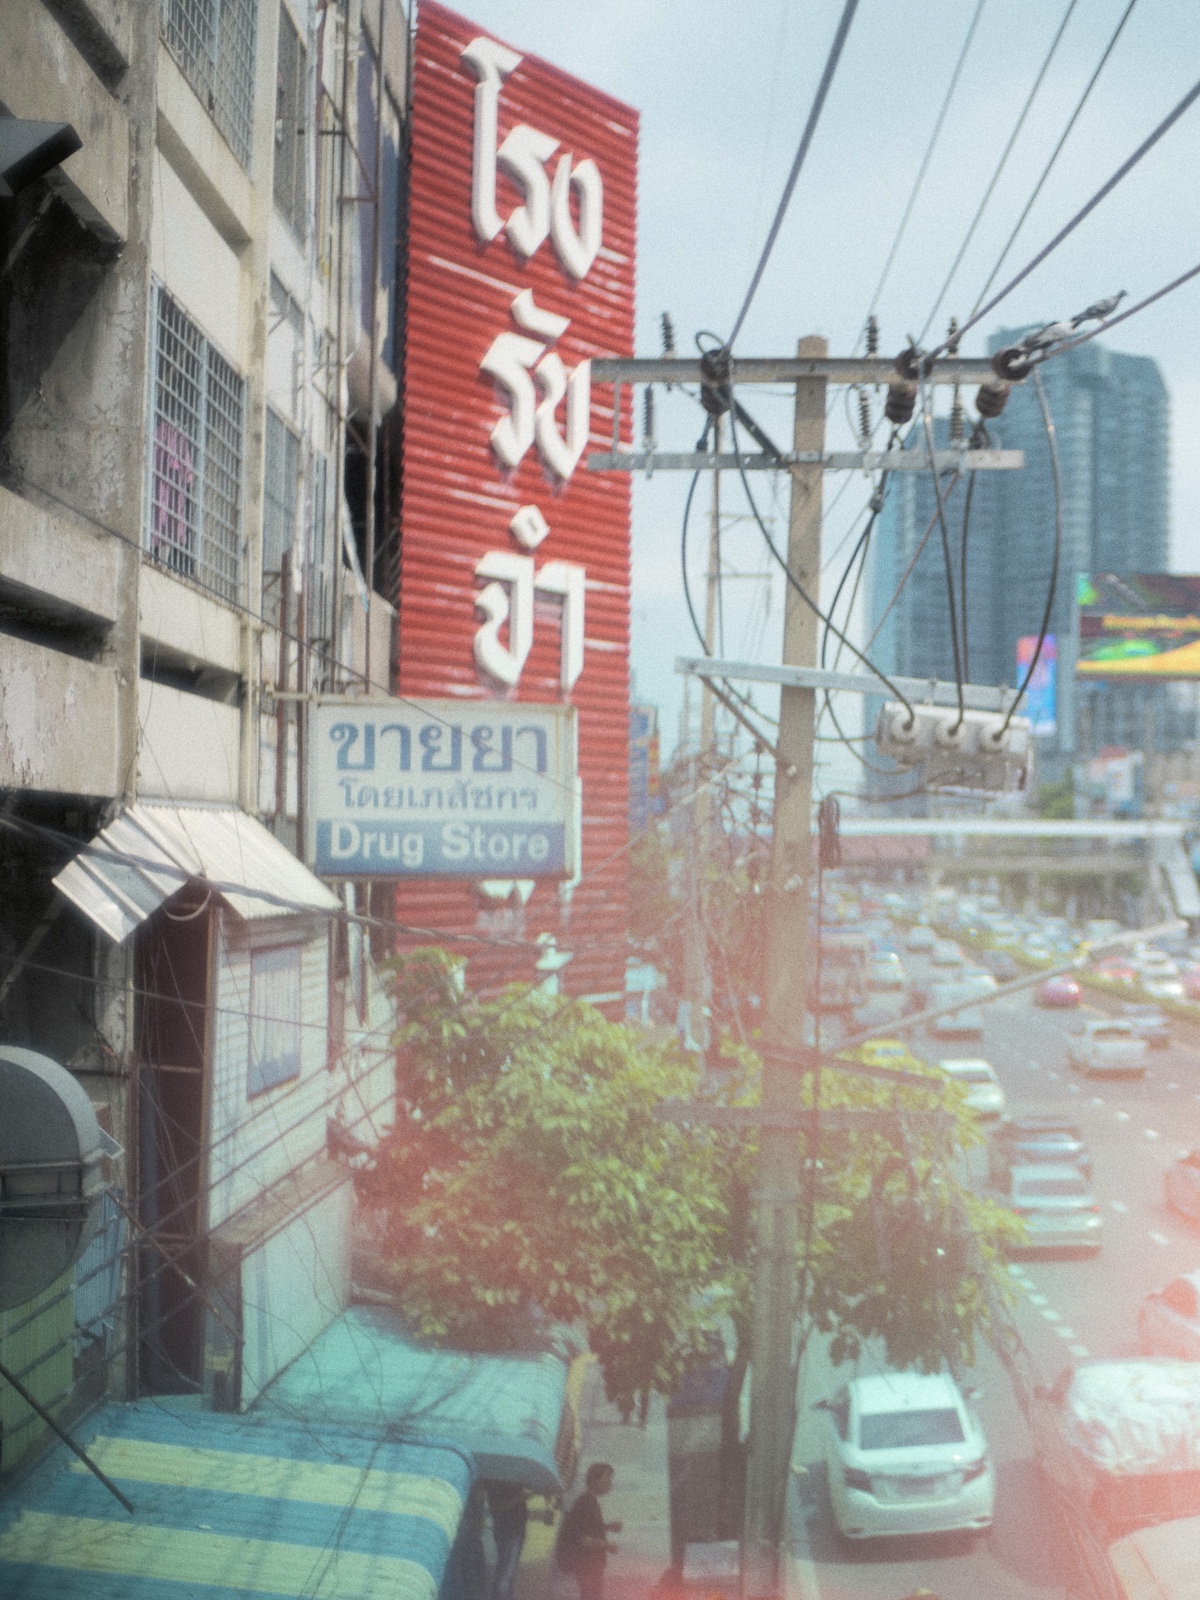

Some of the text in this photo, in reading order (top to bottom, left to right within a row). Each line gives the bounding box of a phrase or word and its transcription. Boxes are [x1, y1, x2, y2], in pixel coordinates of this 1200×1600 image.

[460, 36, 604, 281] โรง
[478, 287, 592, 480] รับ
[473, 504, 586, 694] จำ
[329, 722, 548, 773] ขายยา
[338, 777, 539, 810] โดยเภสัชกร
[330, 820, 550, 868] Drug Store
